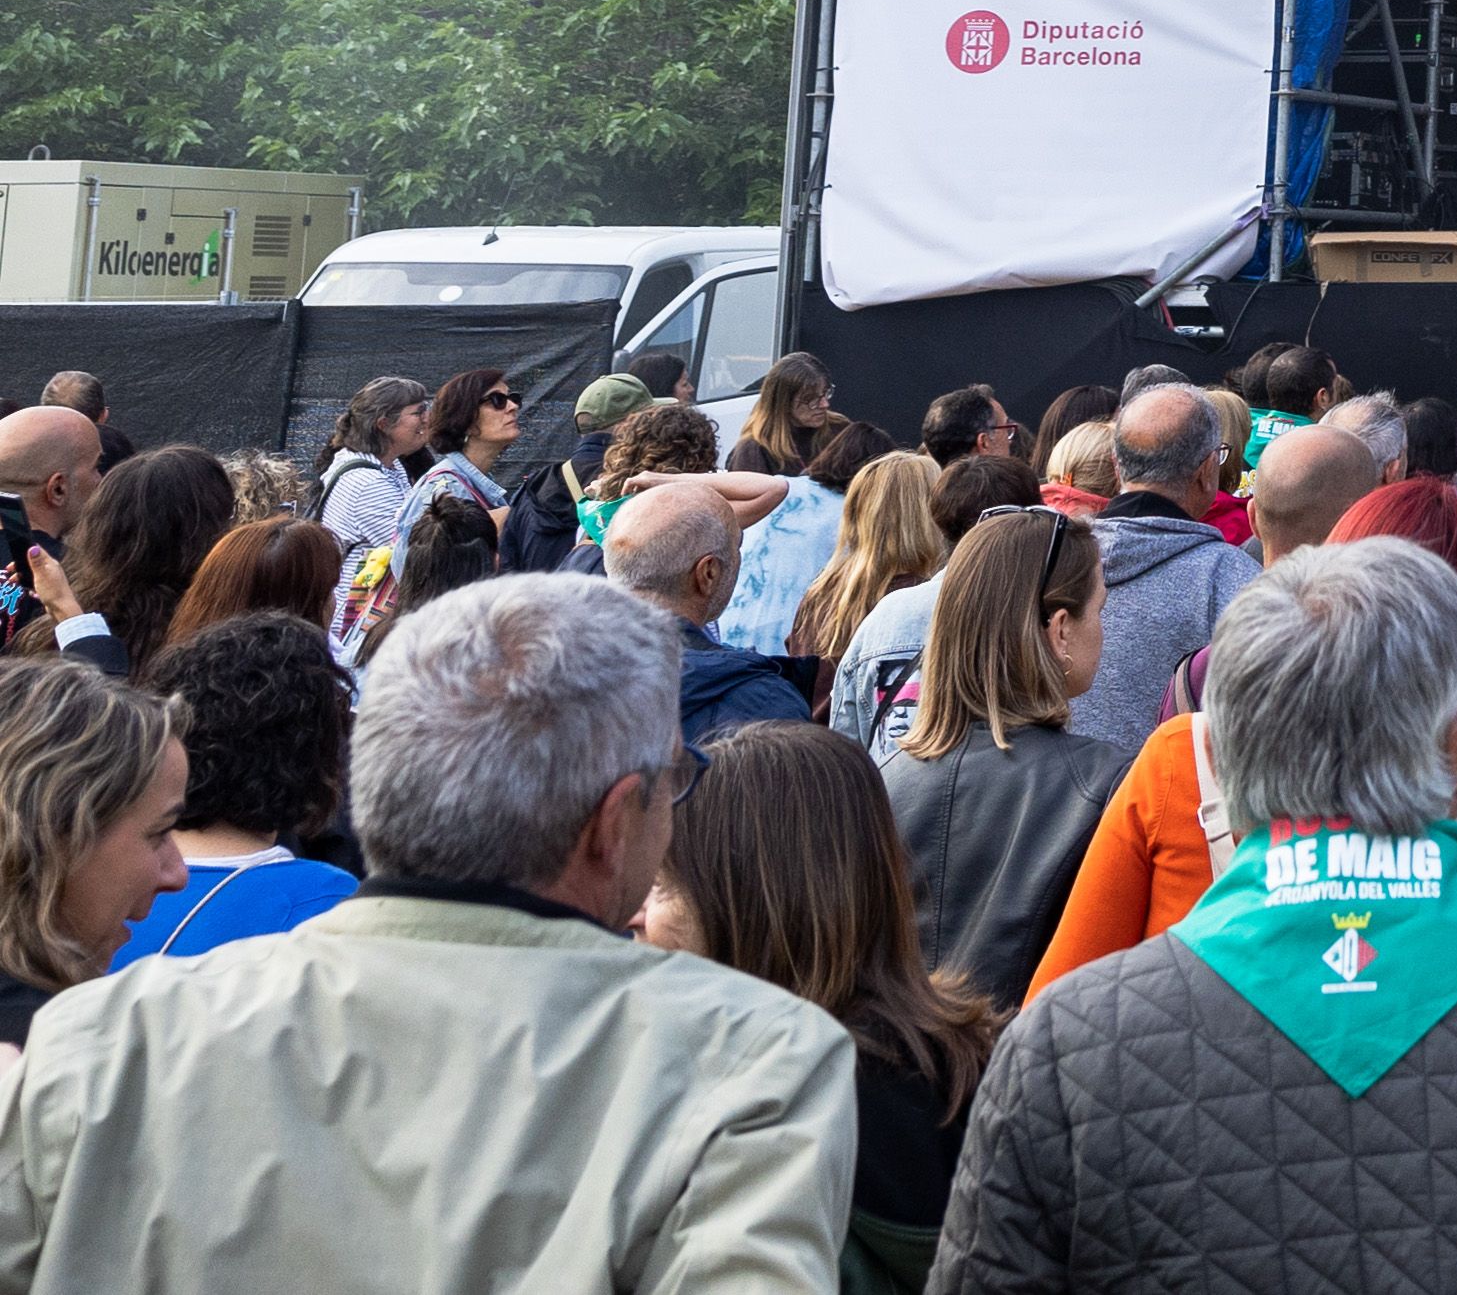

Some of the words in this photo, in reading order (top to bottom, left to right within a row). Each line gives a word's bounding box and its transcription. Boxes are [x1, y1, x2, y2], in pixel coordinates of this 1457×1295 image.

[1023, 21, 1144, 43] Diputació
[1021, 47, 1142, 66] Barcelona
[1265, 838, 1319, 891] DE
[1327, 833, 1443, 881] MAIG
[1358, 882, 1386, 899] DEL
